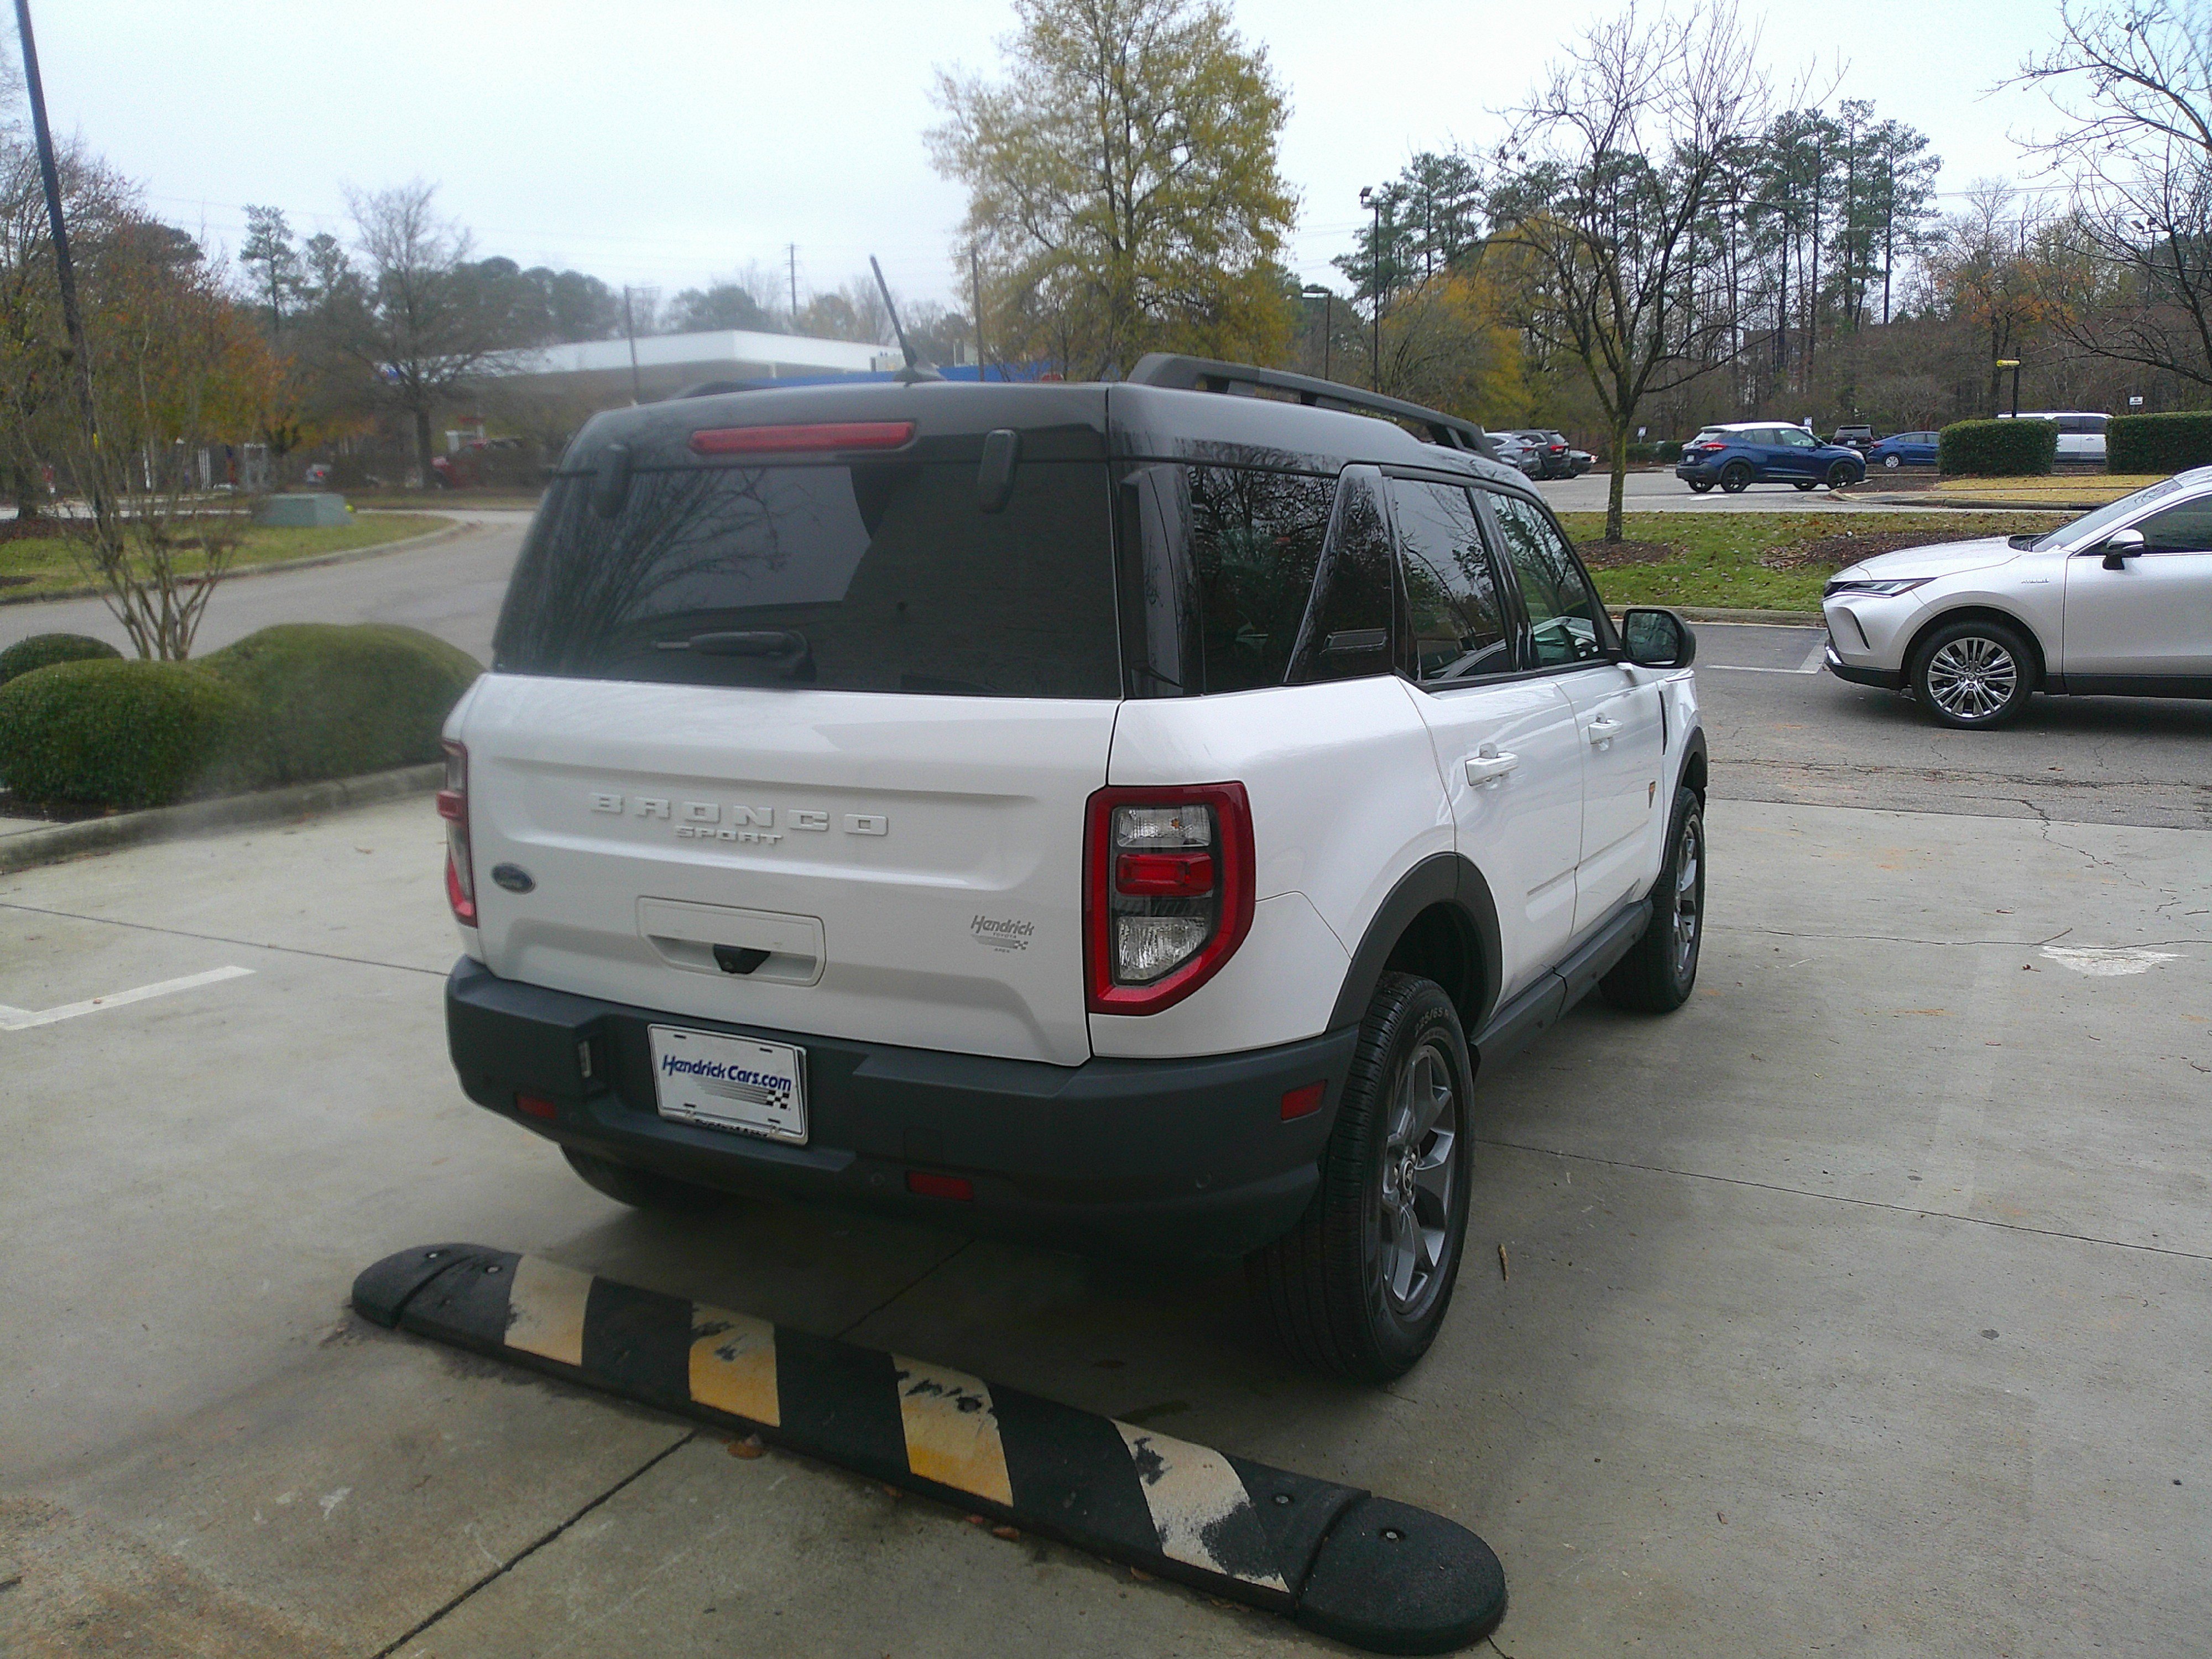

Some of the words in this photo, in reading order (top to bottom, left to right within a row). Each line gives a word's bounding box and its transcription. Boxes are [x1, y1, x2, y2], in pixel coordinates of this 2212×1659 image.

[589, 792, 888, 836] BRONCO
[675, 825, 783, 844] SPORT
[970, 915, 1035, 936] Hendrick
